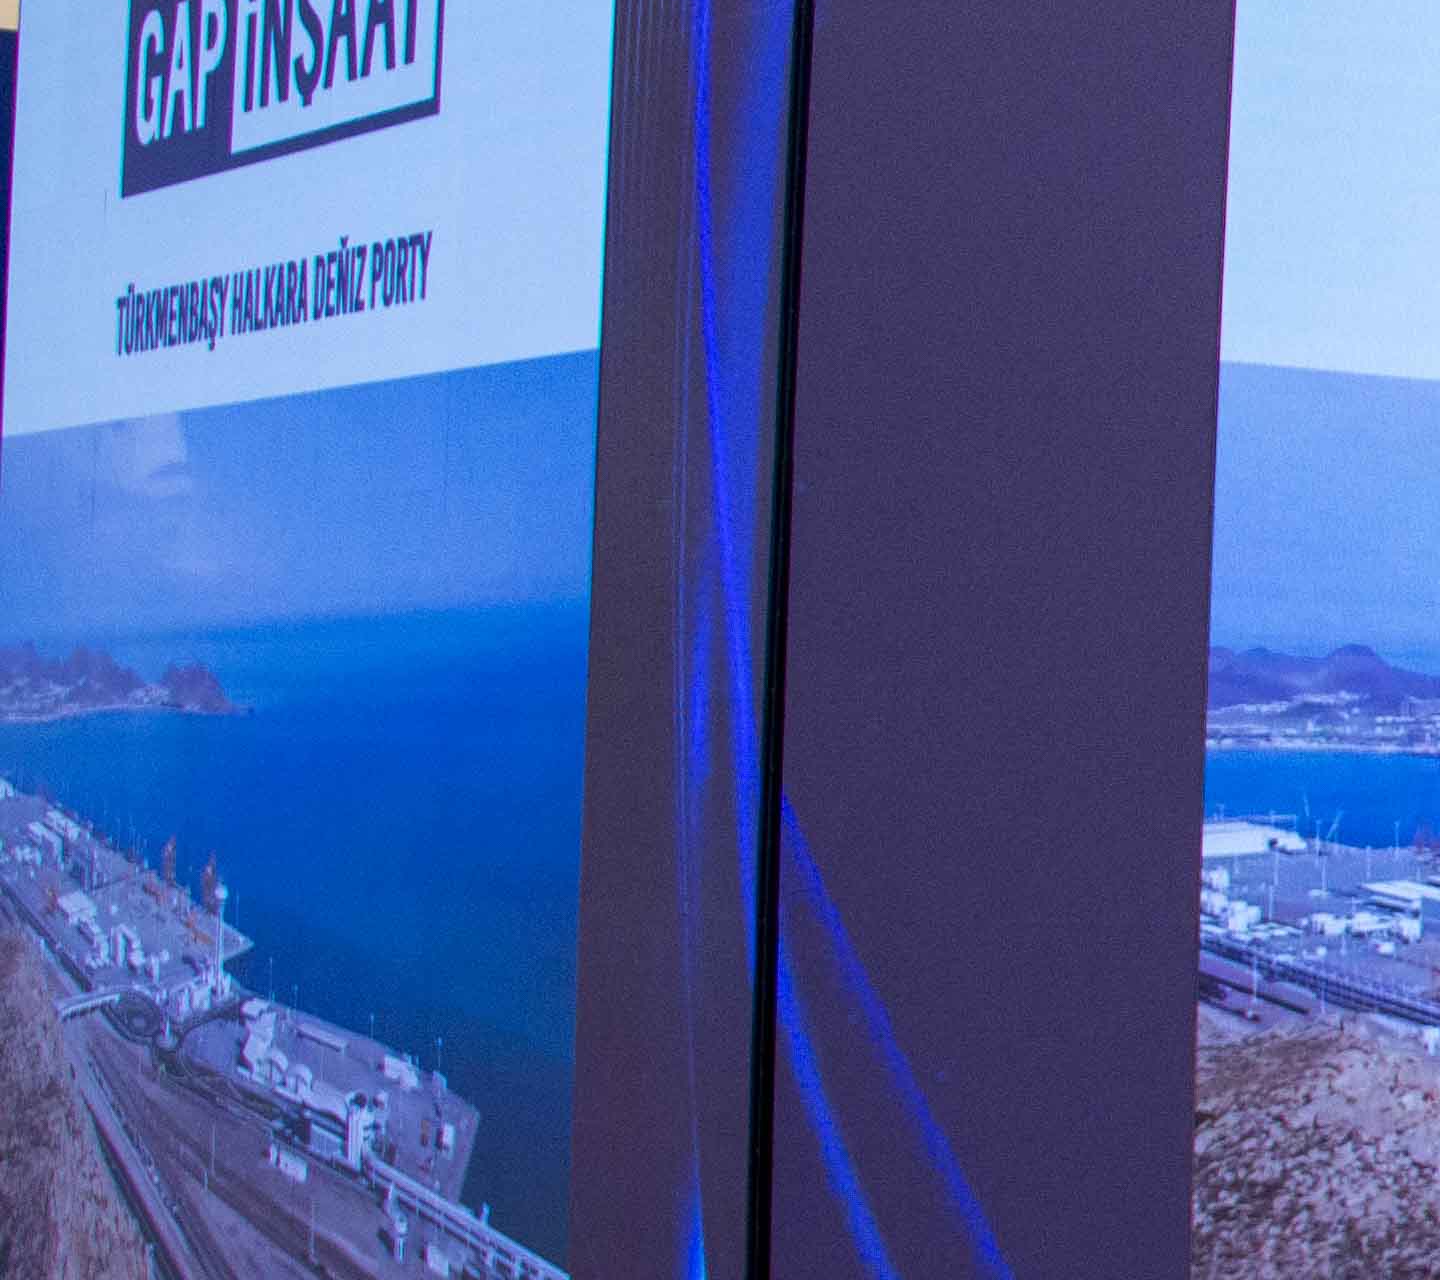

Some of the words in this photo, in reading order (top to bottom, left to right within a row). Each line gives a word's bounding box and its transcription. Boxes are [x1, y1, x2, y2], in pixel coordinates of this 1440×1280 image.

[116, 273, 230, 356] TÜRKMENBAŞY
[231, 258, 307, 332] HALKARA
[370, 231, 432, 306] PORTY
